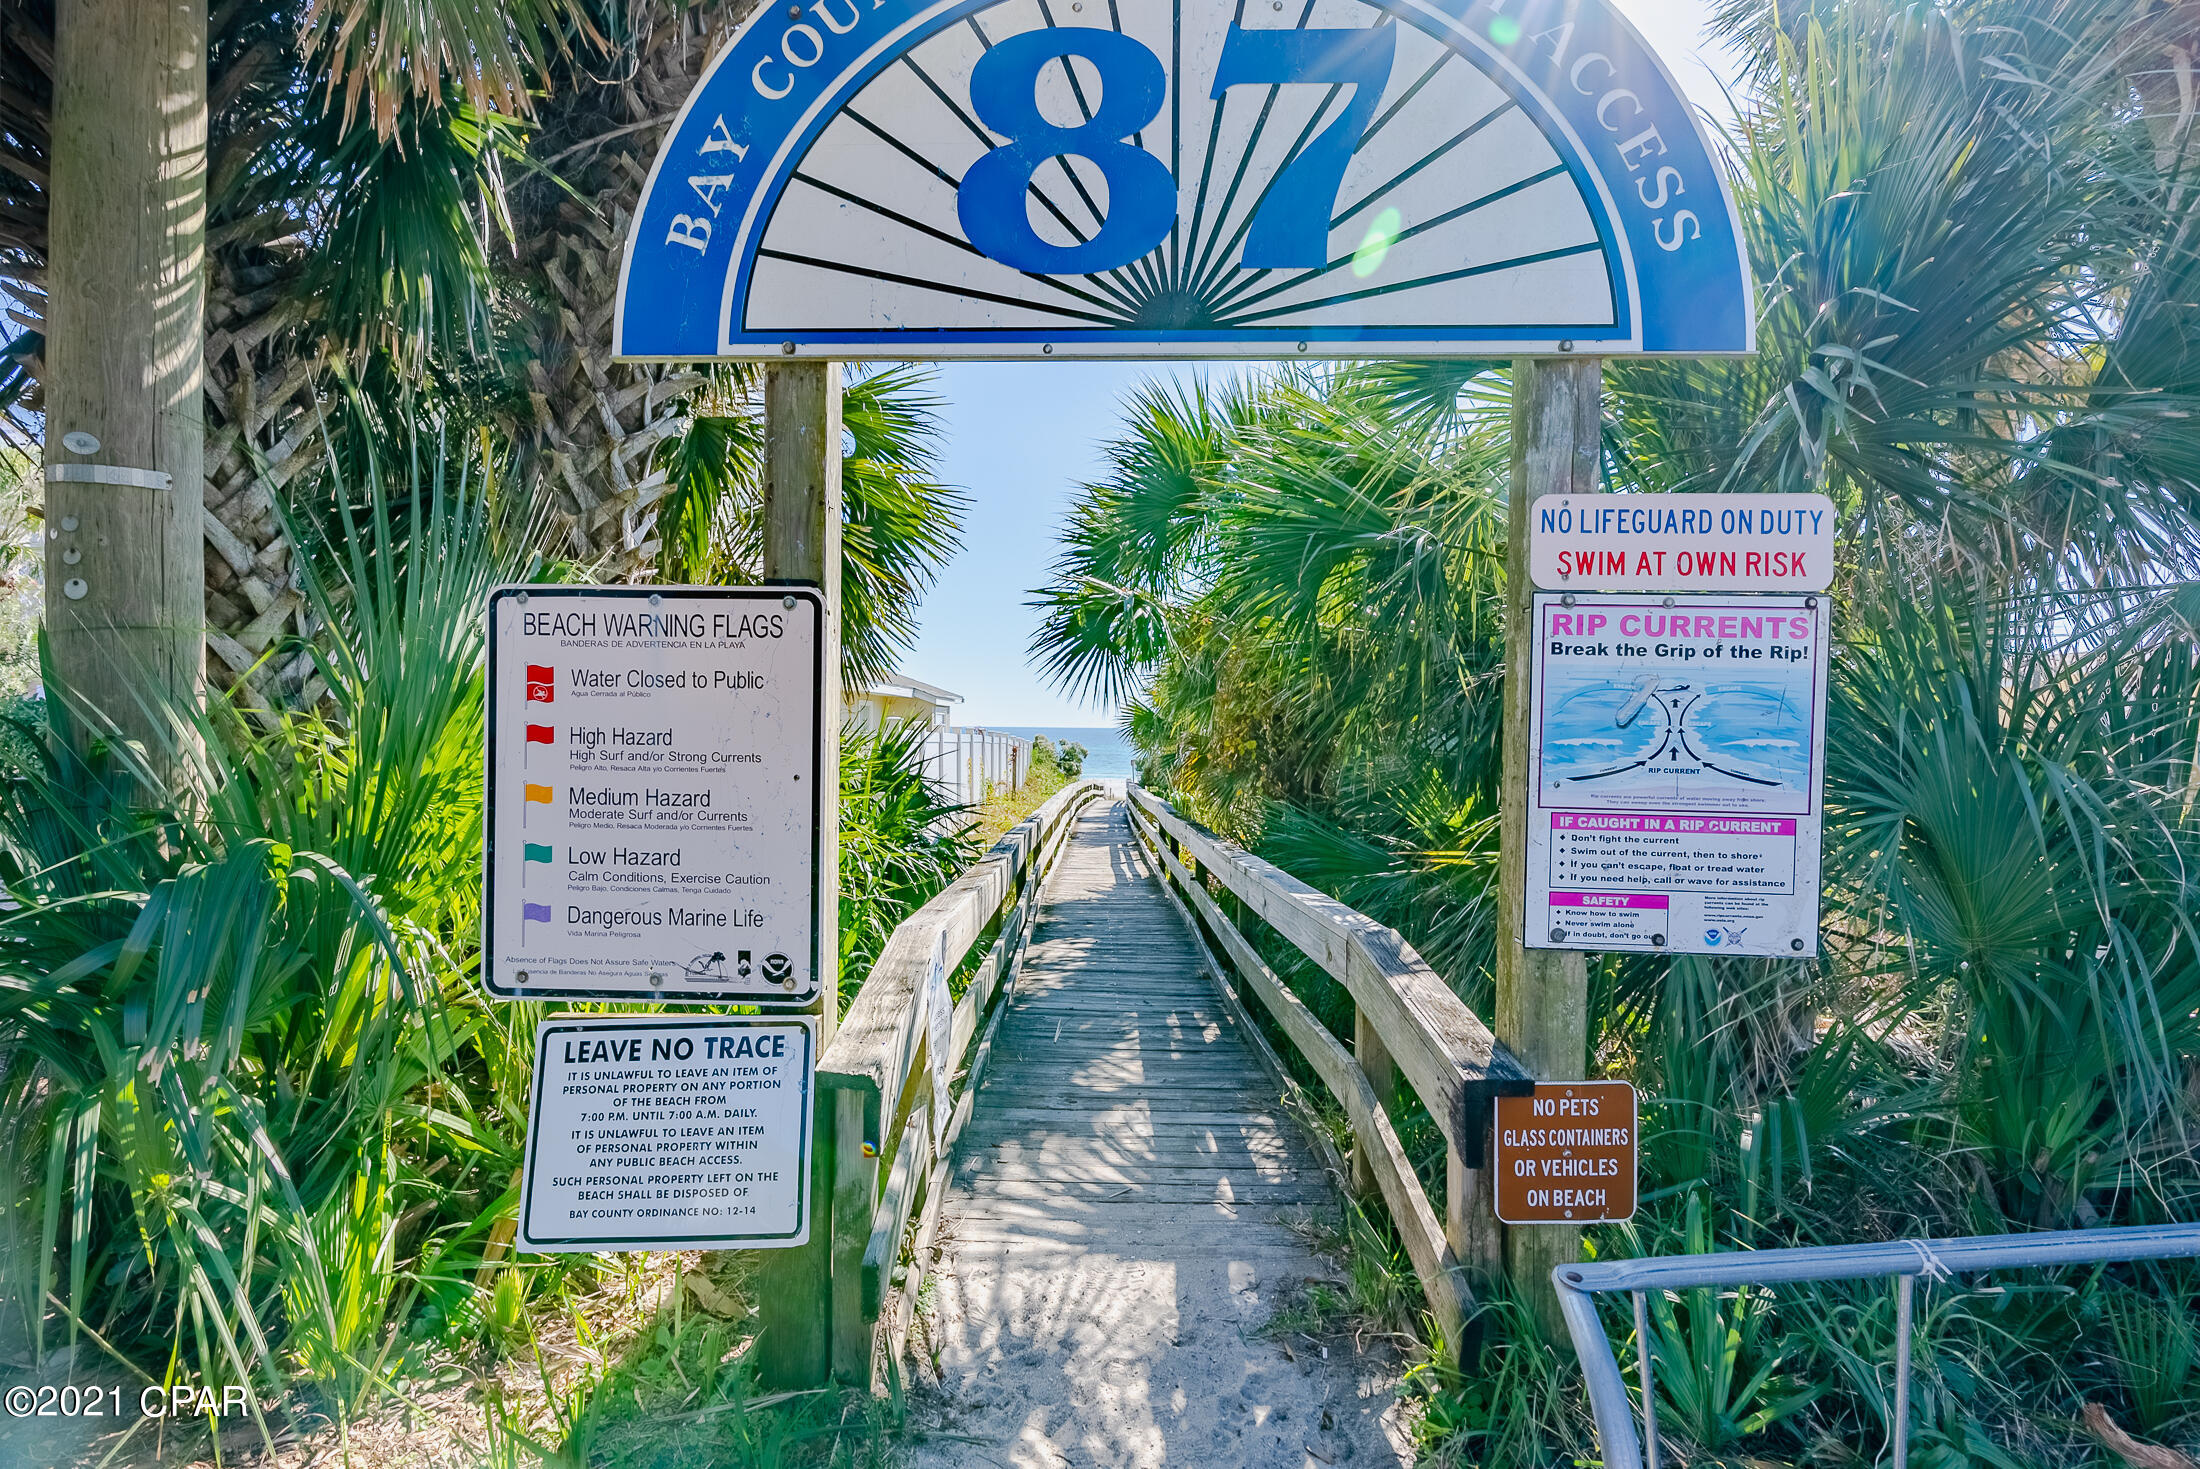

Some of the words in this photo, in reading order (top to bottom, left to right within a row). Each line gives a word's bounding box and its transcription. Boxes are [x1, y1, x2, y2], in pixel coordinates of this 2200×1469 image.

[1528, 20, 1702, 253] ACCESS
[957, 17, 1398, 275] 87
[664, 113, 750, 257] BAY
[1541, 508, 1572, 534] NO
[1580, 509, 1713, 534] LIFEGUARD
[1721, 509, 1753, 535] ON
[1760, 509, 1824, 535] DUTY
[1556, 550, 1625, 577] SWIM
[1635, 551, 1667, 576] AT
[1676, 551, 1736, 577] OWN
[1746, 551, 1807, 577] RISK
[524, 612, 596, 637] BEACH
[603, 613, 705, 638] WARNING
[713, 614, 783, 639] FLAGS
[1550, 613, 1607, 637] RIP
[1619, 614, 1809, 640] CURRENTS
[560, 639, 609, 648] BANDERAS
[611, 640, 623, 648] DE
[625, 640, 688, 649] ADVERTENCIA
[689, 640, 702, 649] EN
[704, 641, 716, 649] LA
[718, 640, 746, 649] PLAYA
[1551, 642, 1609, 656] Break
[1615, 643, 1647, 657] the
[1654, 643, 1696, 661] Grip
[1703, 644, 1723, 658] of
[1730, 645, 1763, 659] the
[1770, 645, 1808, 663] Rip!
[571, 669, 622, 688] Water
[627, 669, 686, 689] Closed
[692, 671, 708, 689] to
[714, 670, 764, 690] Public
[570, 726, 606, 749] High
[612, 727, 672, 746] Hazard
[570, 749, 596, 763] High
[599, 749, 624, 761] Surf
[627, 751, 665, 762] and/or
[668, 750, 707, 765] Strong
[711, 751, 762, 765] Currents
[569, 787, 638, 806] Medium
[646, 788, 711, 808] Hazard
[569, 808, 625, 820] Moderate
[628, 808, 654, 820] Surf
[656, 810, 694, 821] and/or
[697, 810, 748, 822] Currents
[1559, 816, 1574, 827] IF
[1577, 816, 1641, 829] CAUGHT
[1644, 818, 1660, 830] IN
[1664, 819, 1675, 830] A
[1679, 819, 1705, 831] RIP
[1708, 820, 1782, 833] CURRENT
[1571, 834, 1596, 842] Don't
[1599, 834, 1621, 844] fight
[1624, 835, 1640, 843] the
[568, 846, 607, 865] Low
[613, 847, 681, 867] Hazard
[1570, 847, 1597, 855] Swim
[1632, 849, 1648, 857] the
[1650, 851, 1690, 859] current,
[1693, 851, 1715, 859] then
[568, 870, 599, 882] Calm
[602, 871, 667, 884] Conditions,
[671, 872, 721, 884] Exercise
[725, 873, 770, 885] Caution
[1570, 873, 1577, 881] If
[1580, 875, 1598, 883] you
[1600, 875, 1624, 883] need
[1627, 875, 1651, 885] help,
[1653, 876, 1672, 884] call
[1674, 875, 1685, 884] or
[1715, 878, 1730, 886] for
[1732, 879, 1786, 888] assistance
[1582, 895, 1630, 906] SAFETY
[568, 905, 662, 929] Dangerous
[669, 907, 727, 927] Marine
[733, 909, 764, 928] Life
[564, 1039, 642, 1064] LEAVE
[651, 1037, 694, 1061] NO
[704, 1035, 787, 1059] TRACE
[568, 1072, 578, 1081] IT
[580, 1071, 590, 1081] IS
[594, 1070, 654, 1081] UNLAWFUL
[657, 1069, 672, 1079] TO
[675, 1068, 709, 1078] LEAVE
[711, 1067, 729, 1077] AN
[732, 1067, 759, 1077] ITEM
[762, 1066, 778, 1076] OF
[562, 1084, 619, 1095] PERSONAL
[622, 1082, 678, 1093] PROPERTY
[680, 1082, 699, 1092] ON
[702, 1081, 727, 1091] ANY
[729, 1079, 781, 1090] PORTION
[613, 1097, 628, 1107] OF
[631, 1097, 652, 1107] THE
[655, 1096, 691, 1106] BEACH
[694, 1095, 726, 1105] FROM
[1533, 1099, 1555, 1116] NO
[1559, 1098, 1599, 1116] PETS
[581, 1112, 605, 1122] 7:00
[608, 1112, 628, 1121] P.M.
[632, 1111, 665, 1121] UNTIL
[668, 1110, 692, 1120] 7:00
[695, 1109, 720, 1119] A.M.
[724, 1108, 758, 1118] DAILY.
[1504, 1129, 1546, 1147] GLASS
[1549, 1128, 1629, 1147] CONTAINERS
[576, 1144, 592, 1154] OF
[595, 1143, 653, 1153] PERSONAL
[656, 1141, 712, 1152] PROPERTY
[715, 1140, 758, 1150] WITHIN
[589, 1158, 613, 1168] ANY
[616, 1157, 656, 1167] PUBLIC
[659, 1156, 695, 1167] BEACH
[698, 1155, 742, 1165] ACCESS.
[1514, 1159, 1536, 1177] OR
[1540, 1158, 1618, 1177] VEHICLES
[552, 1176, 582, 1187] SUCH
[585, 1175, 644, 1186] PERSONAL
[647, 1174, 704, 1185] PROPERTY
[707, 1173, 732, 1183] LEFT
[735, 1172, 753, 1183] ON
[757, 1171, 779, 1182] THE
[578, 1190, 614, 1201] BEACH
[617, 1190, 652, 1200] SHALL
[656, 1189, 669, 1199] BE
[673, 1188, 729, 1199] DISPOSED
[733, 1187, 749, 1197] OF
[1527, 1189, 1549, 1207] ON
[1553, 1189, 1606, 1207] BEACH
[569, 1210, 589, 1219] BAY
[591, 1209, 634, 1219] COUNTY
[636, 1207, 699, 1218] ORDINANCE
[702, 1207, 723, 1216] NO:
[727, 1206, 756, 1215] 12-14
